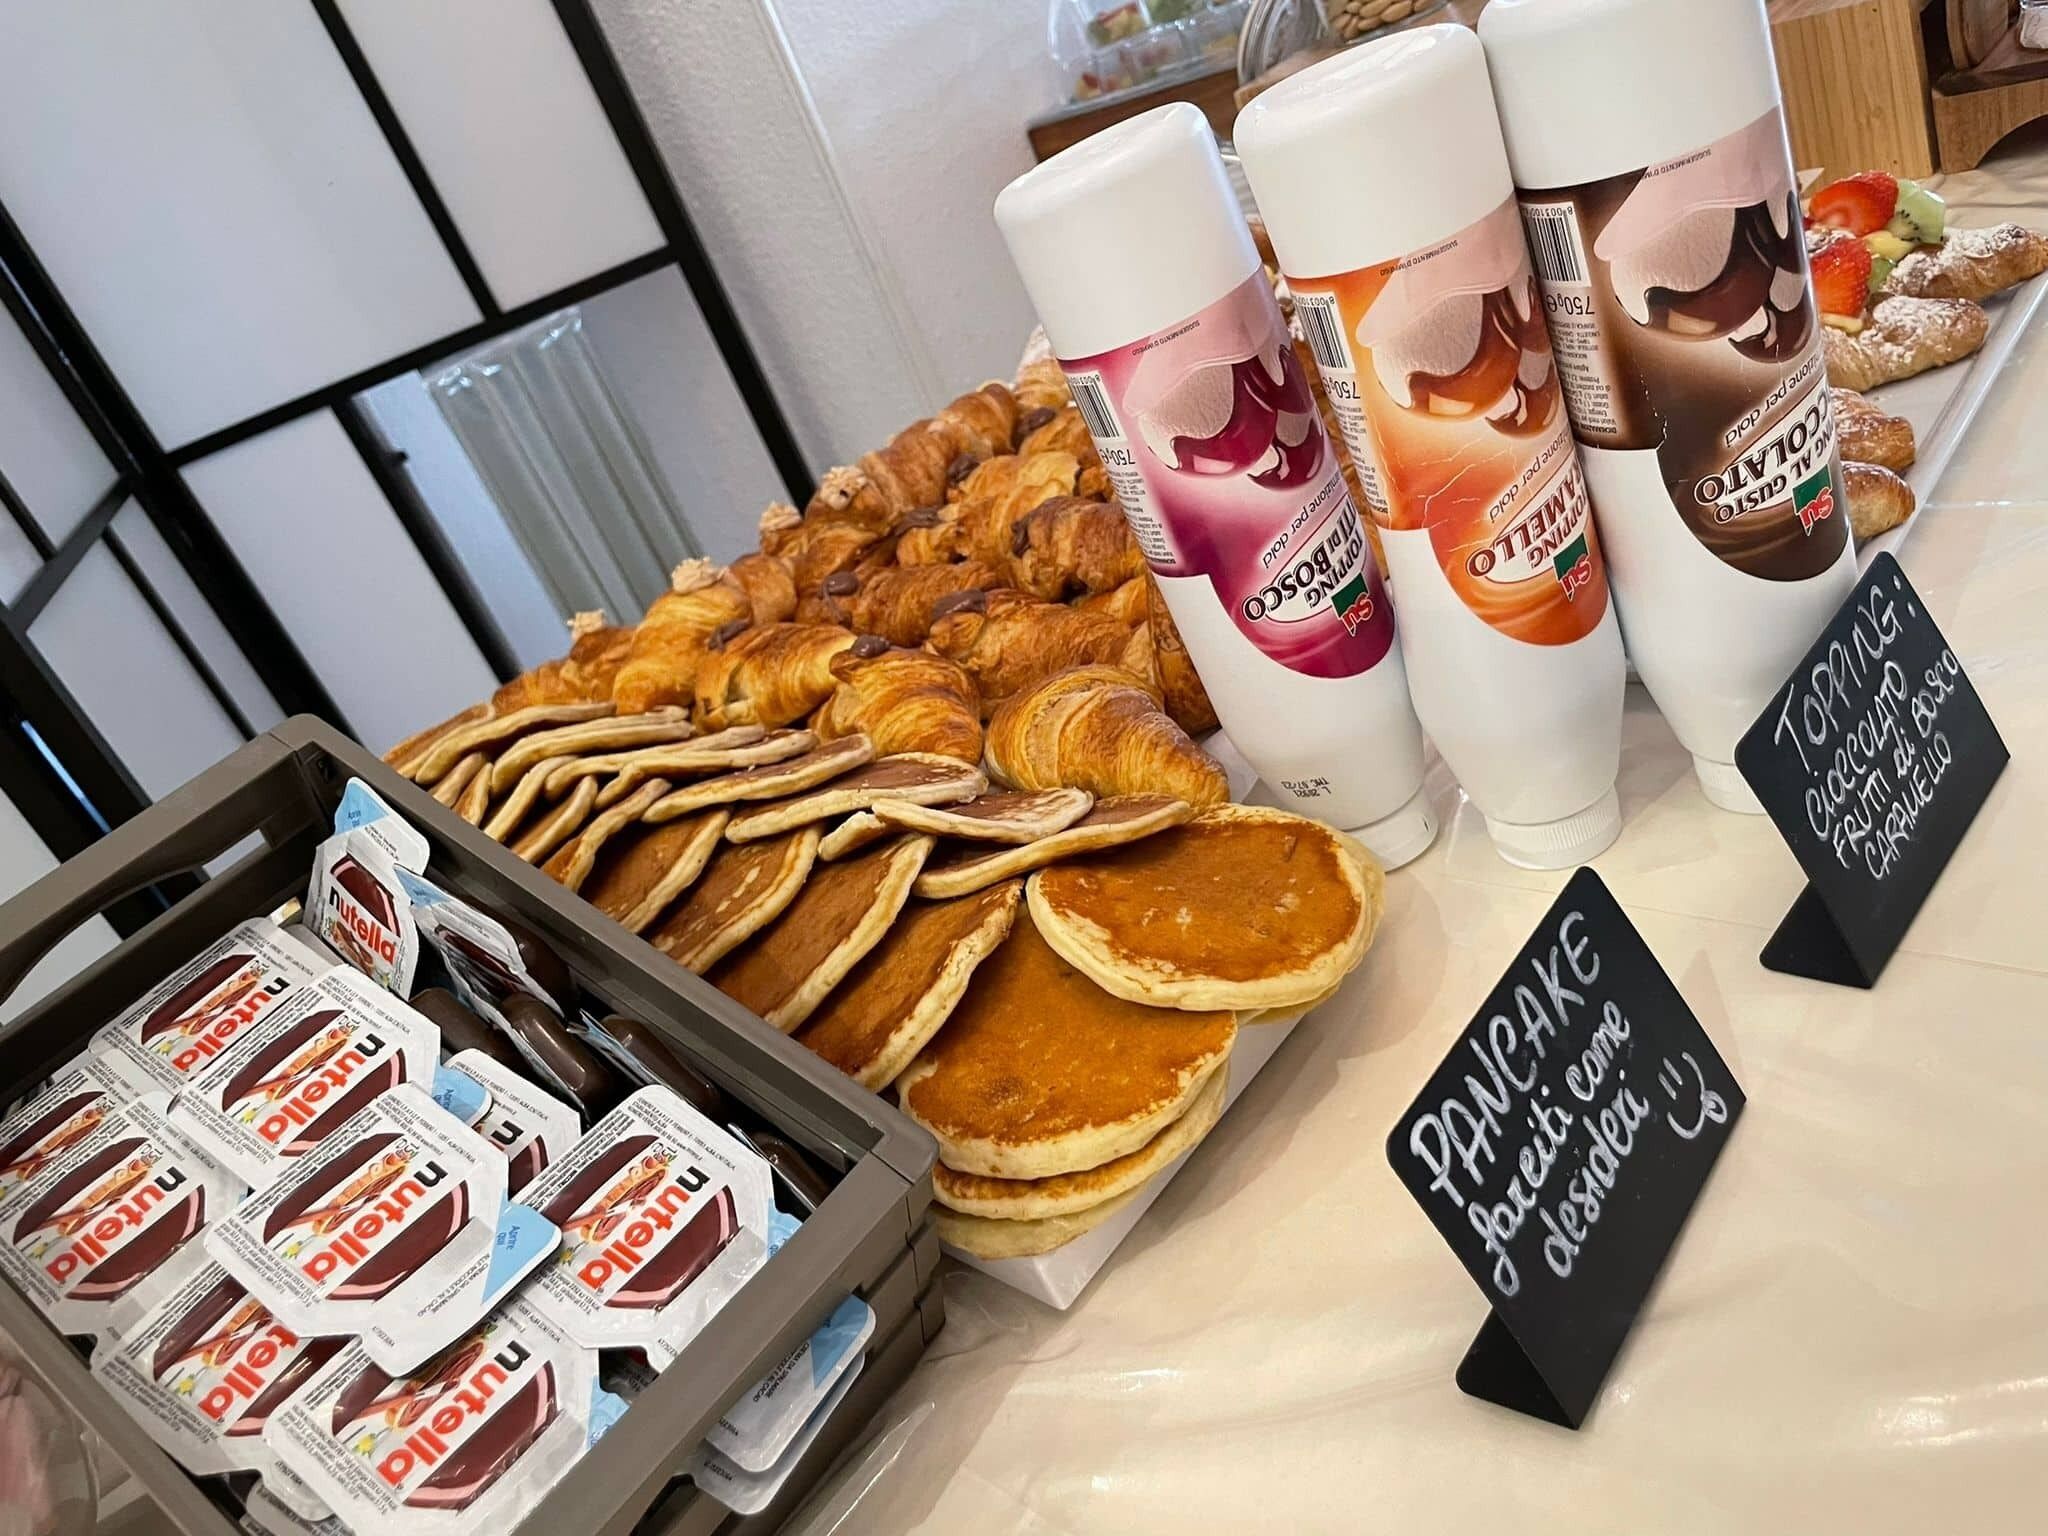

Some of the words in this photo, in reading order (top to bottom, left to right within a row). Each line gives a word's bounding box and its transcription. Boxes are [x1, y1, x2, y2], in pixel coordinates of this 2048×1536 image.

[1724, 408, 1761, 448] dolci
[1765, 379, 1786, 413] per
[1489, 484, 1519, 523] dolci
[1522, 457, 1541, 487] per
[1714, 475, 1787, 524] GUSTO
[1790, 447, 1812, 479] AL
[1262, 532, 1289, 569] dolci
[1291, 504, 1309, 535] per
[1326, 526, 1342, 554] DI
[1242, 541, 1332, 621] BOSCO
[1304, 528, 1363, 609] TOPPING
[1832, 767, 1892, 870] FRUTTI
[1893, 728, 1916, 780] di
[1911, 648, 1960, 739] BOSCO
[1864, 730, 1953, 881] CARAMELLO
[329, 886, 397, 966] nutella
[171, 977, 291, 1072] nutella
[1410, 911, 1600, 1208] PANCAKE
[1565, 1000, 1630, 1101] come
[257, 1033, 386, 1143] nutella
[46, 1166, 187, 1283] nutella
[301, 1160, 449, 1285] nutella
[577, 1166, 711, 1290] nutella
[198, 1325, 299, 1420] tella
[376, 1340, 531, 1486] nutella
